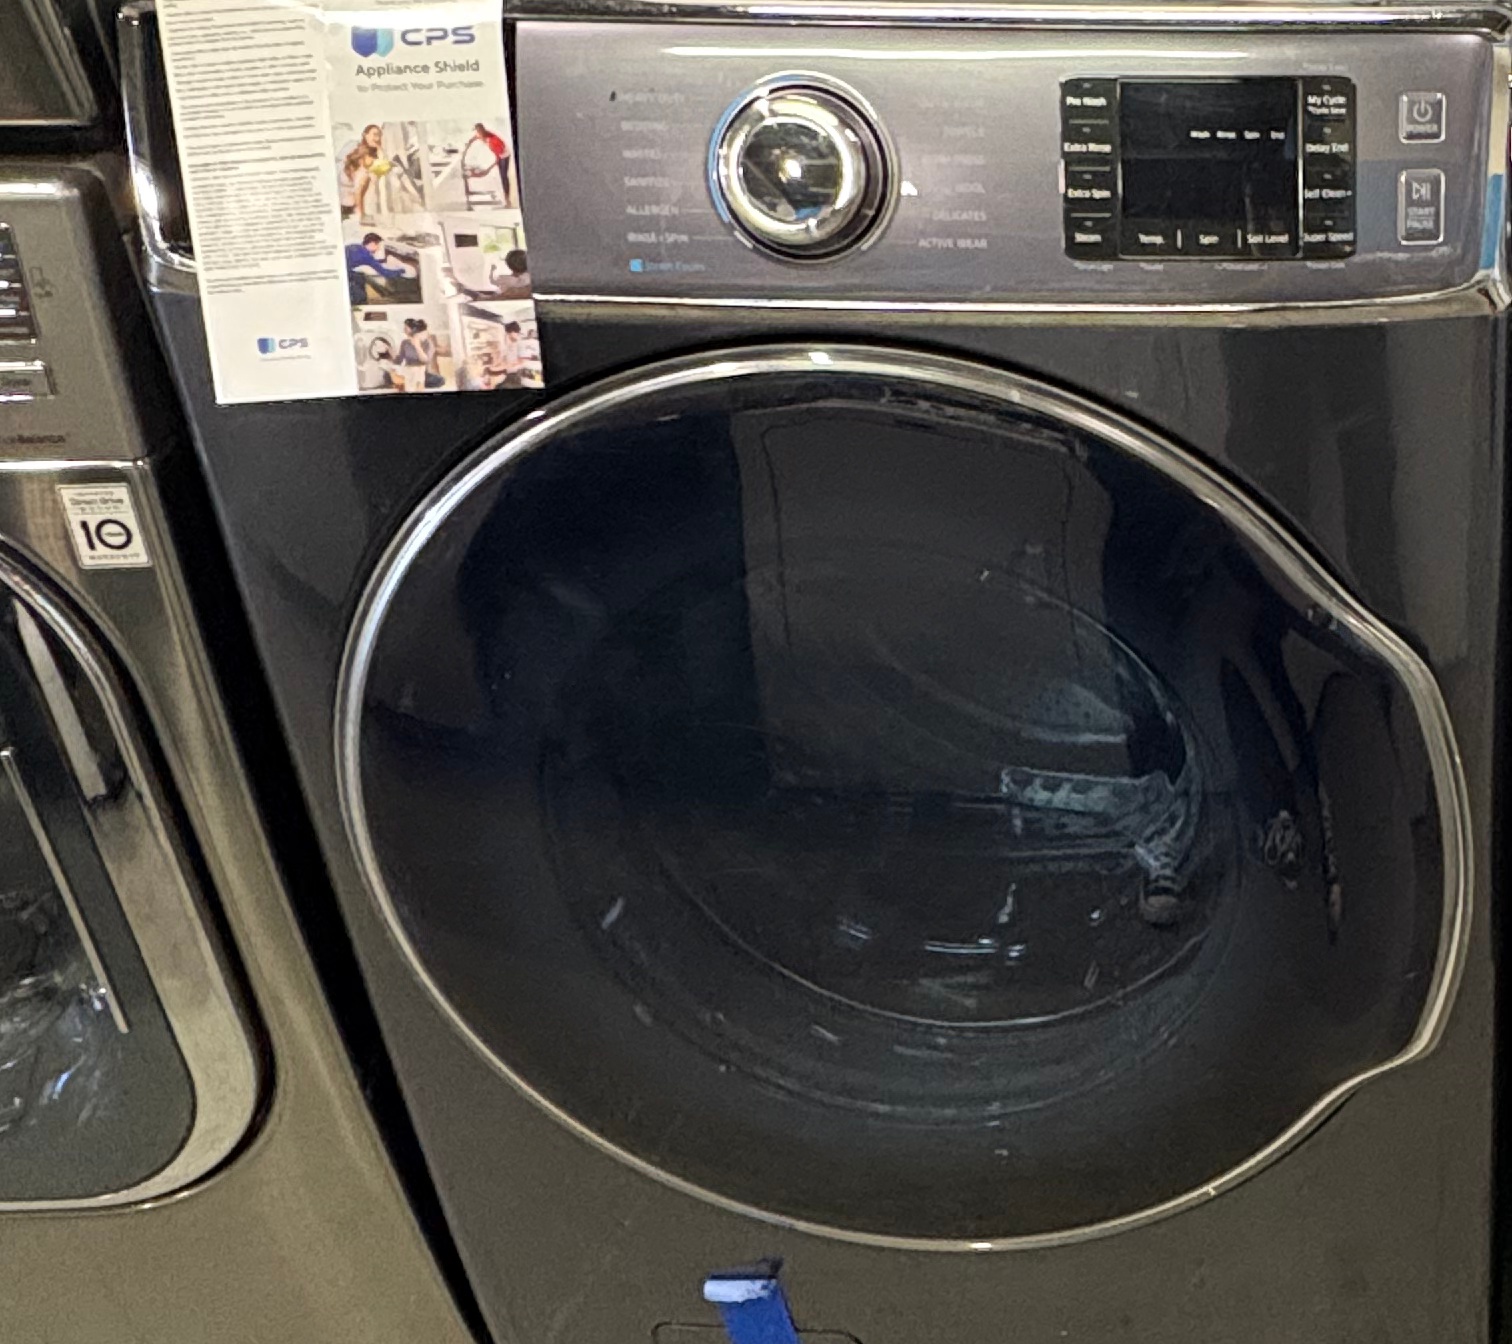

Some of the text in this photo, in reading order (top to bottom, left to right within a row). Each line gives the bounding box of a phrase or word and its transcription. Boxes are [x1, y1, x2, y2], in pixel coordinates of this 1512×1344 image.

[400, 25, 475, 46] CPS
[355, 60, 480, 78] Appliance Shield
[278, 337, 309, 349] CPS
[80, 519, 133, 550] 10
